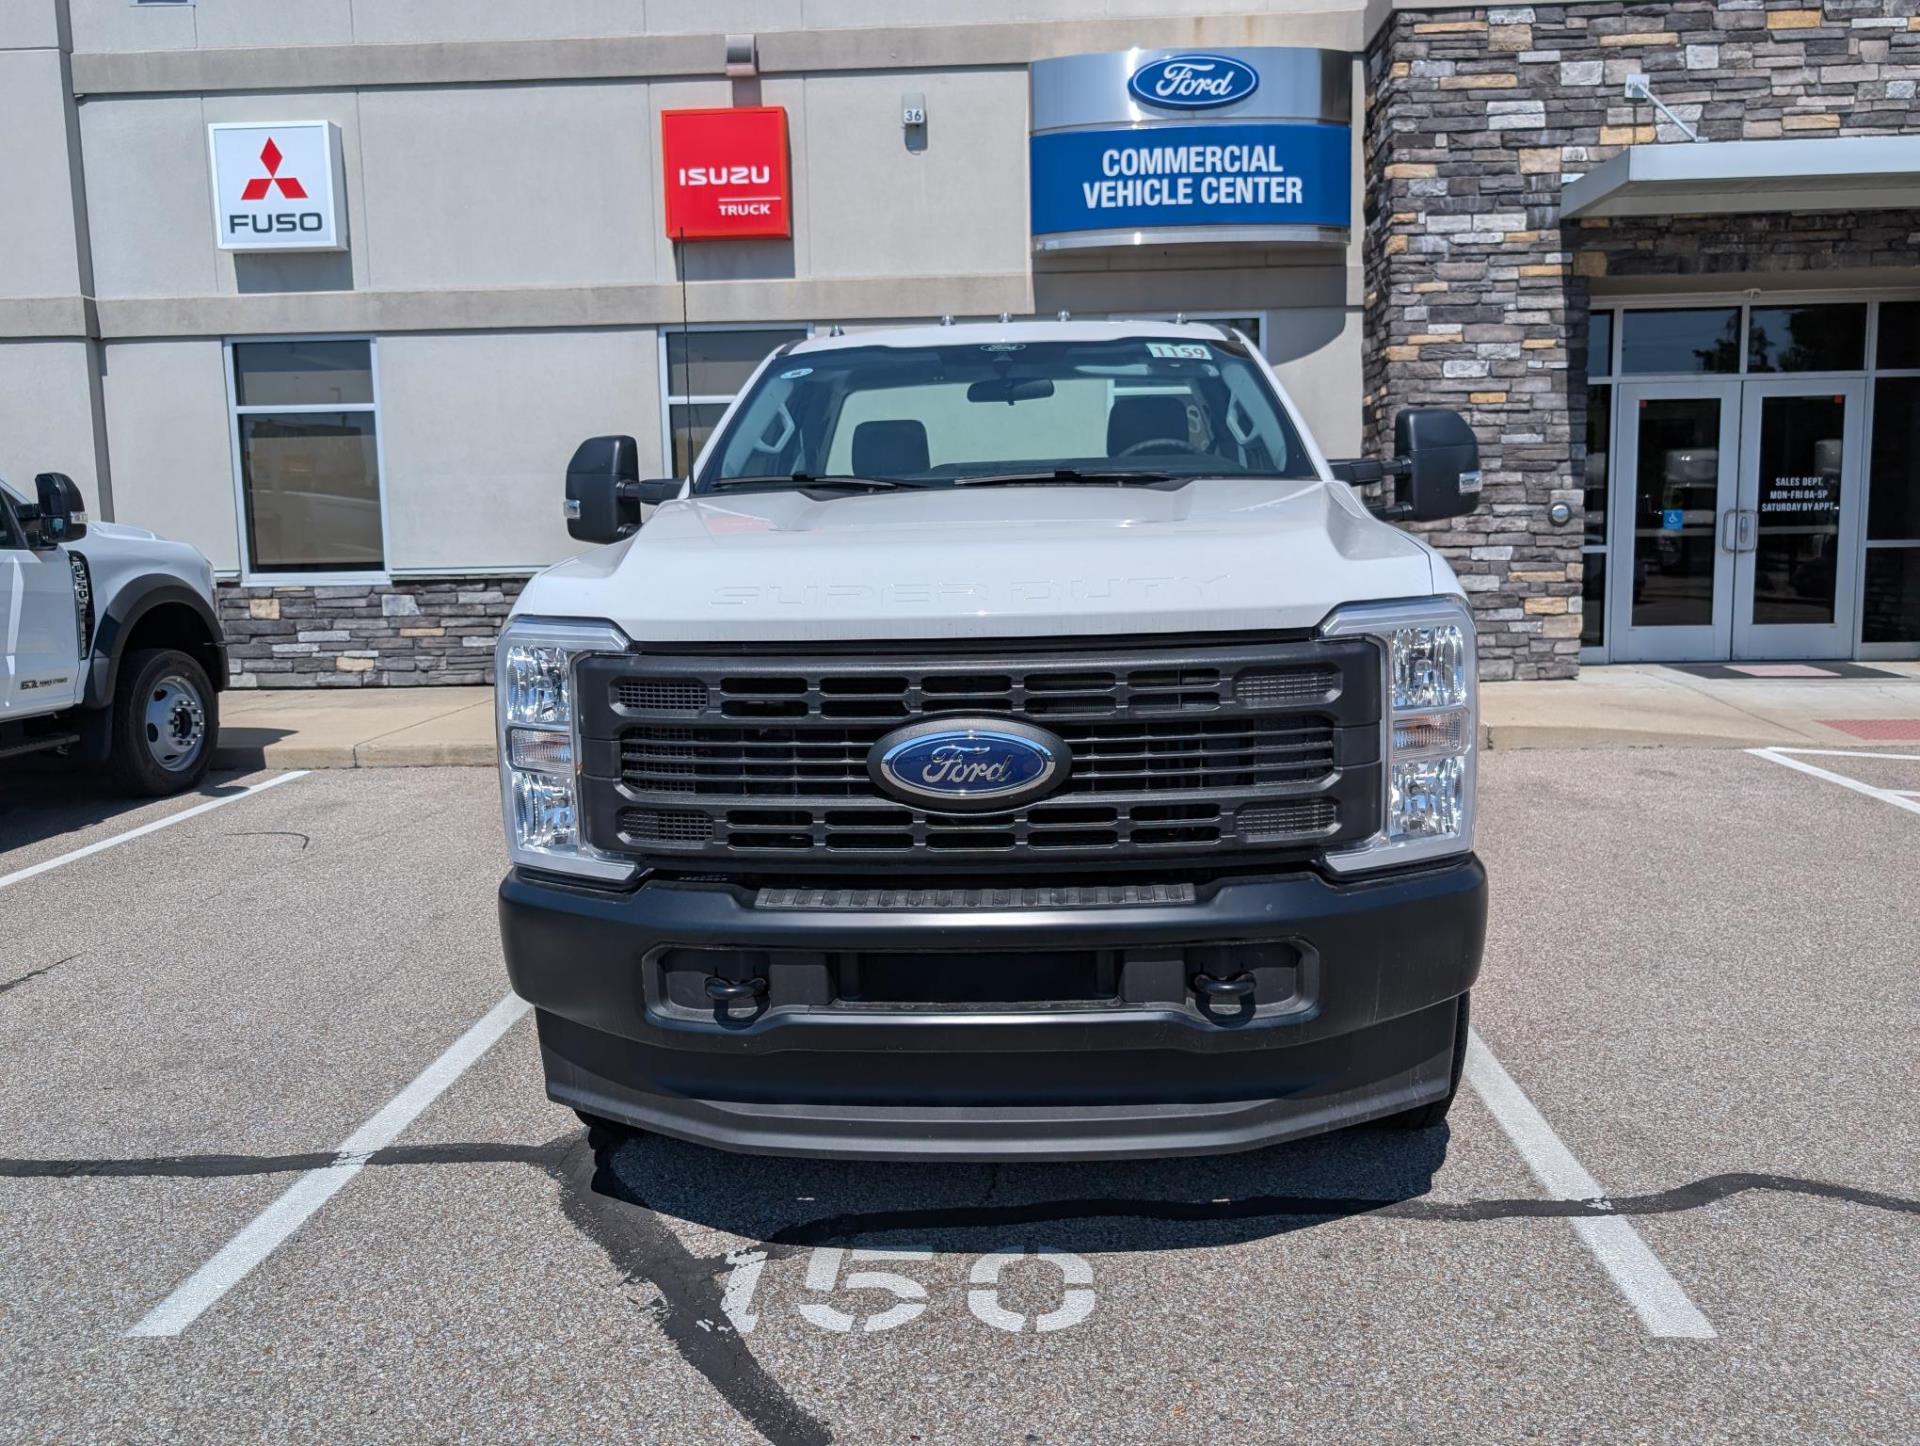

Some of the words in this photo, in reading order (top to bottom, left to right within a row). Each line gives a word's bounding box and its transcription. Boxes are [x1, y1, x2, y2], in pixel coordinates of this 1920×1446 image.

[1155, 63, 1235, 96] Ford
[905, 110, 922, 122] 36
[1102, 145, 1284, 177] COMMERCIAL
[679, 165, 770, 187] ISUZU
[1082, 177, 1193, 209] VEHICLE
[1201, 176, 1303, 205] CENTER
[718, 203, 770, 216] TRUCK
[229, 212, 323, 234] FUSO
[1776, 477, 1800, 486] SALES
[1762, 503, 1801, 512] SATURDAY
[708, 578, 991, 607] SUPER
[1009, 572, 1232, 602] DUTY
[922, 745, 1015, 783] Ford
